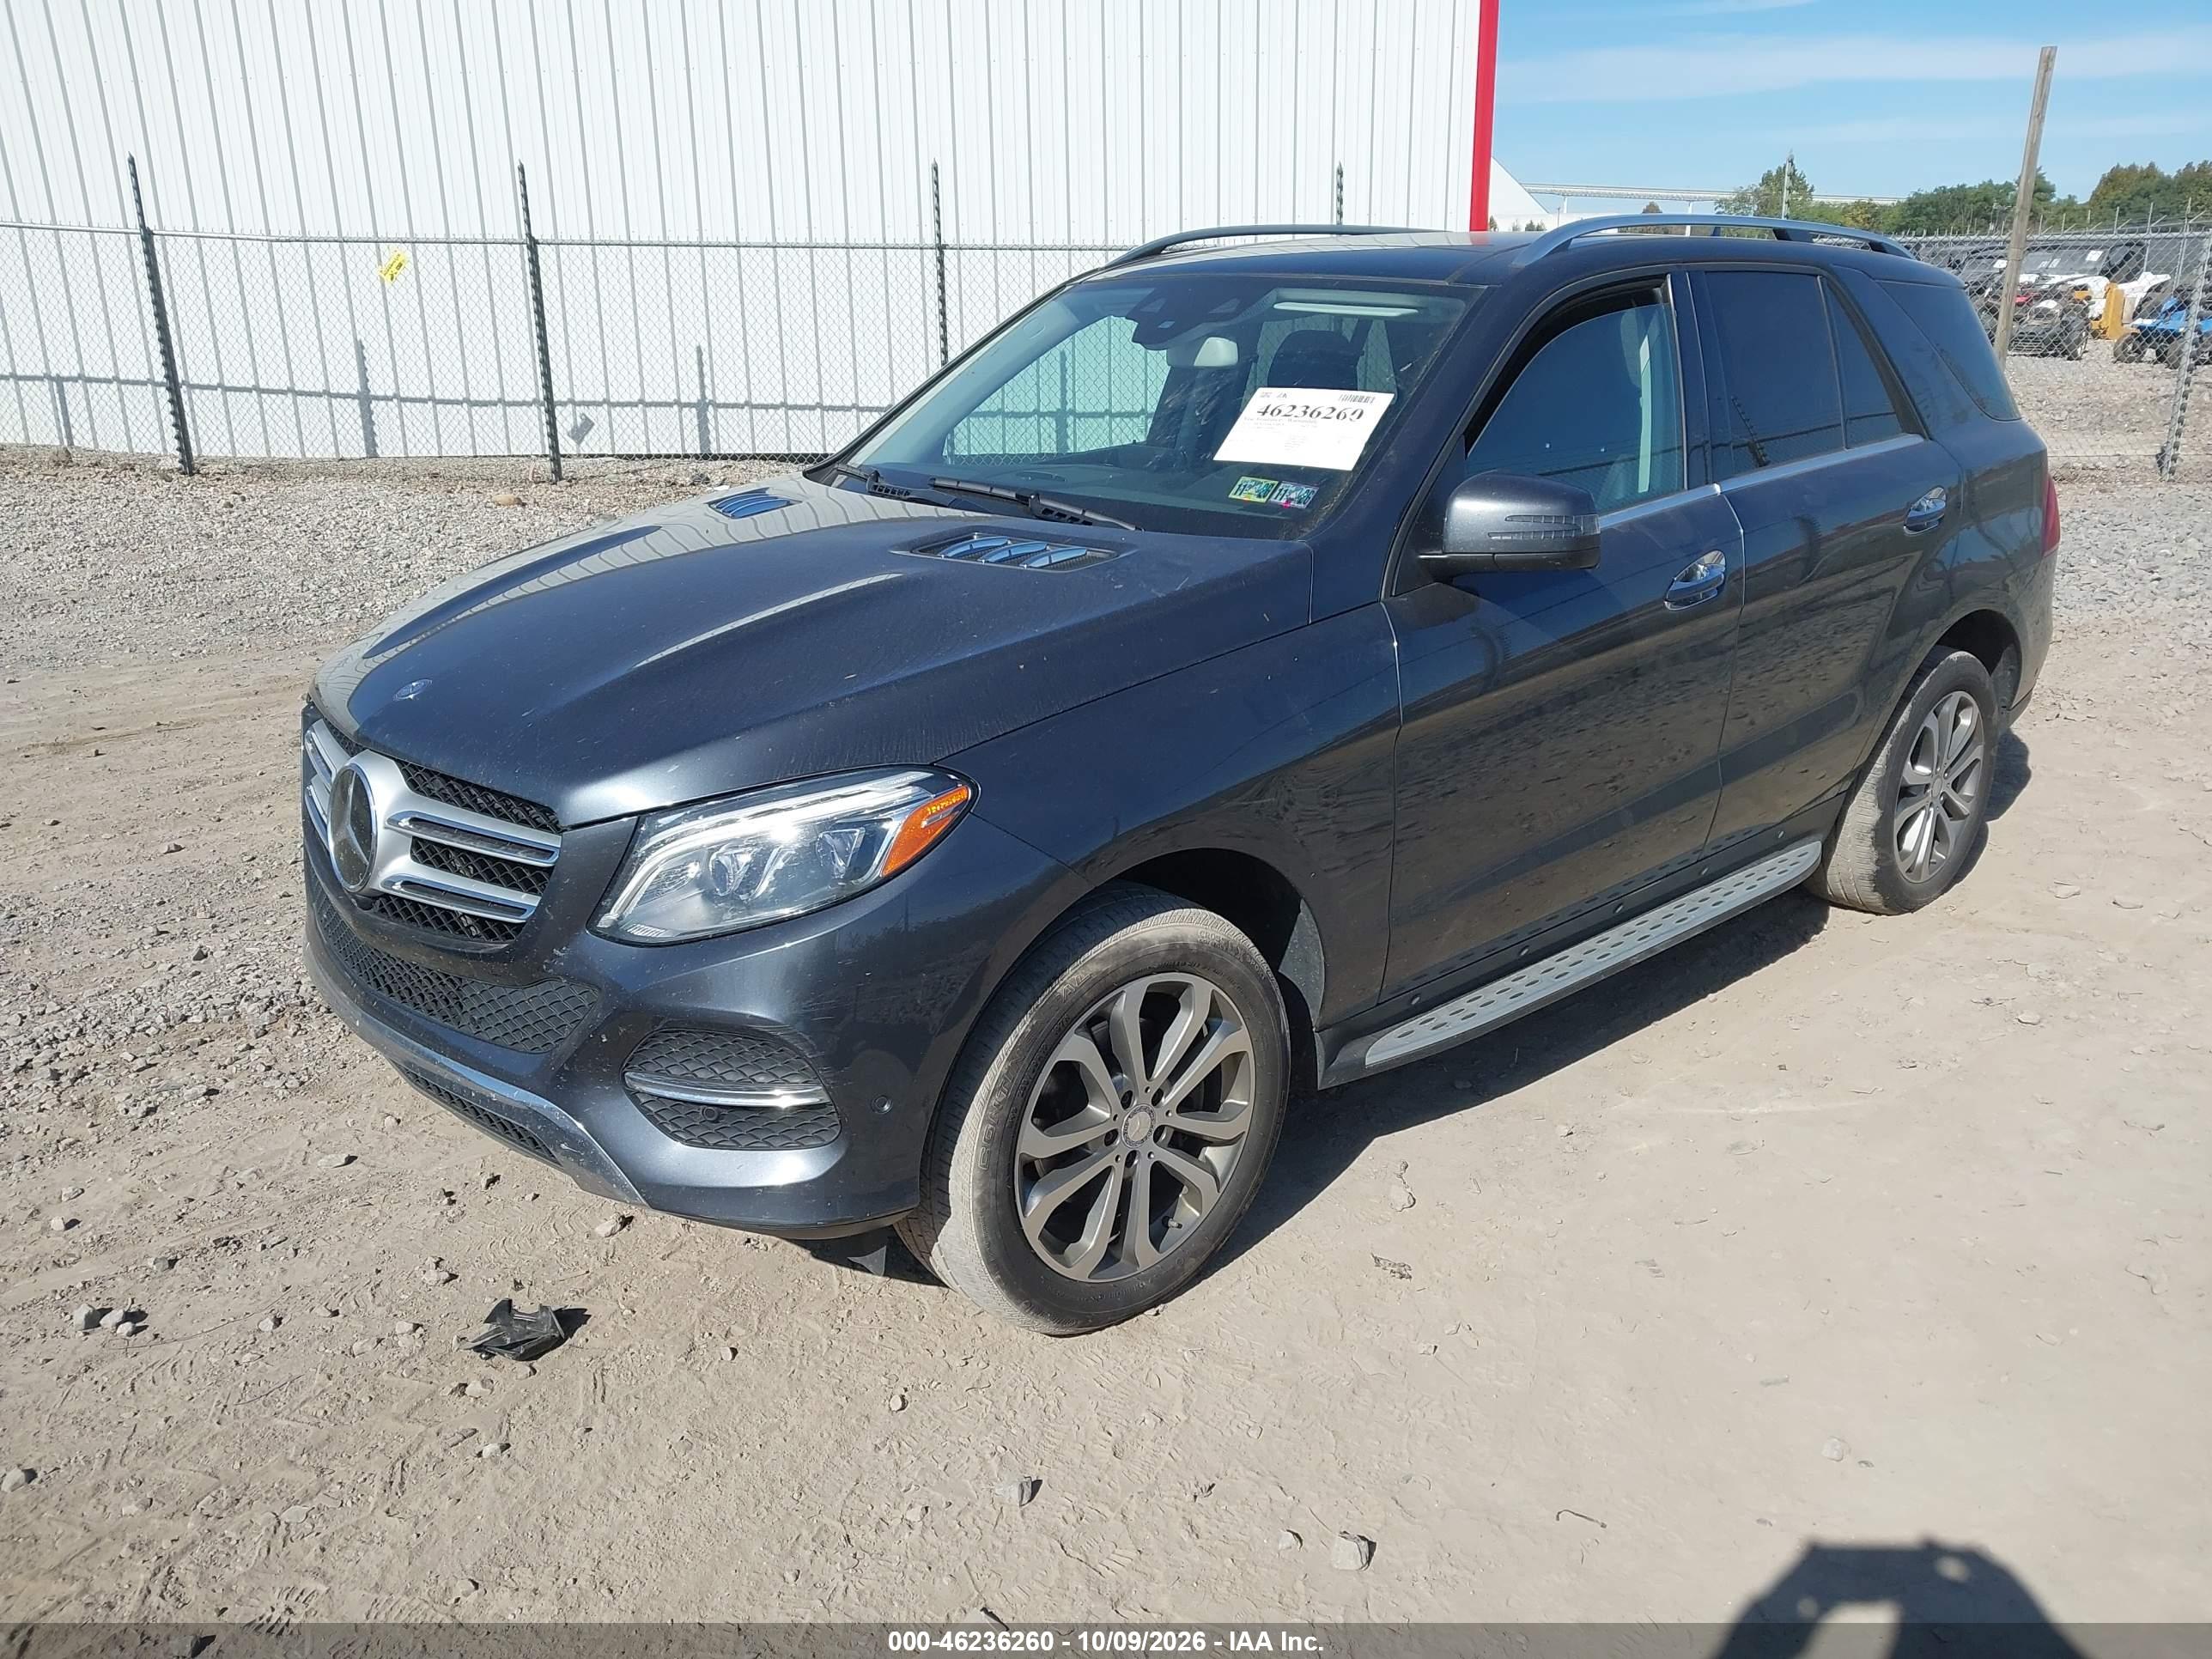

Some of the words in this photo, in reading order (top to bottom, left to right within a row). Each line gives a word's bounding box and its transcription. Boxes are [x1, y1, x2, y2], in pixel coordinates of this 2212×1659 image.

[1234, 483, 1247, 496] 11
[1274, 488, 1288, 501] 11
[978, 973, 1091, 1170] CONTINAL
